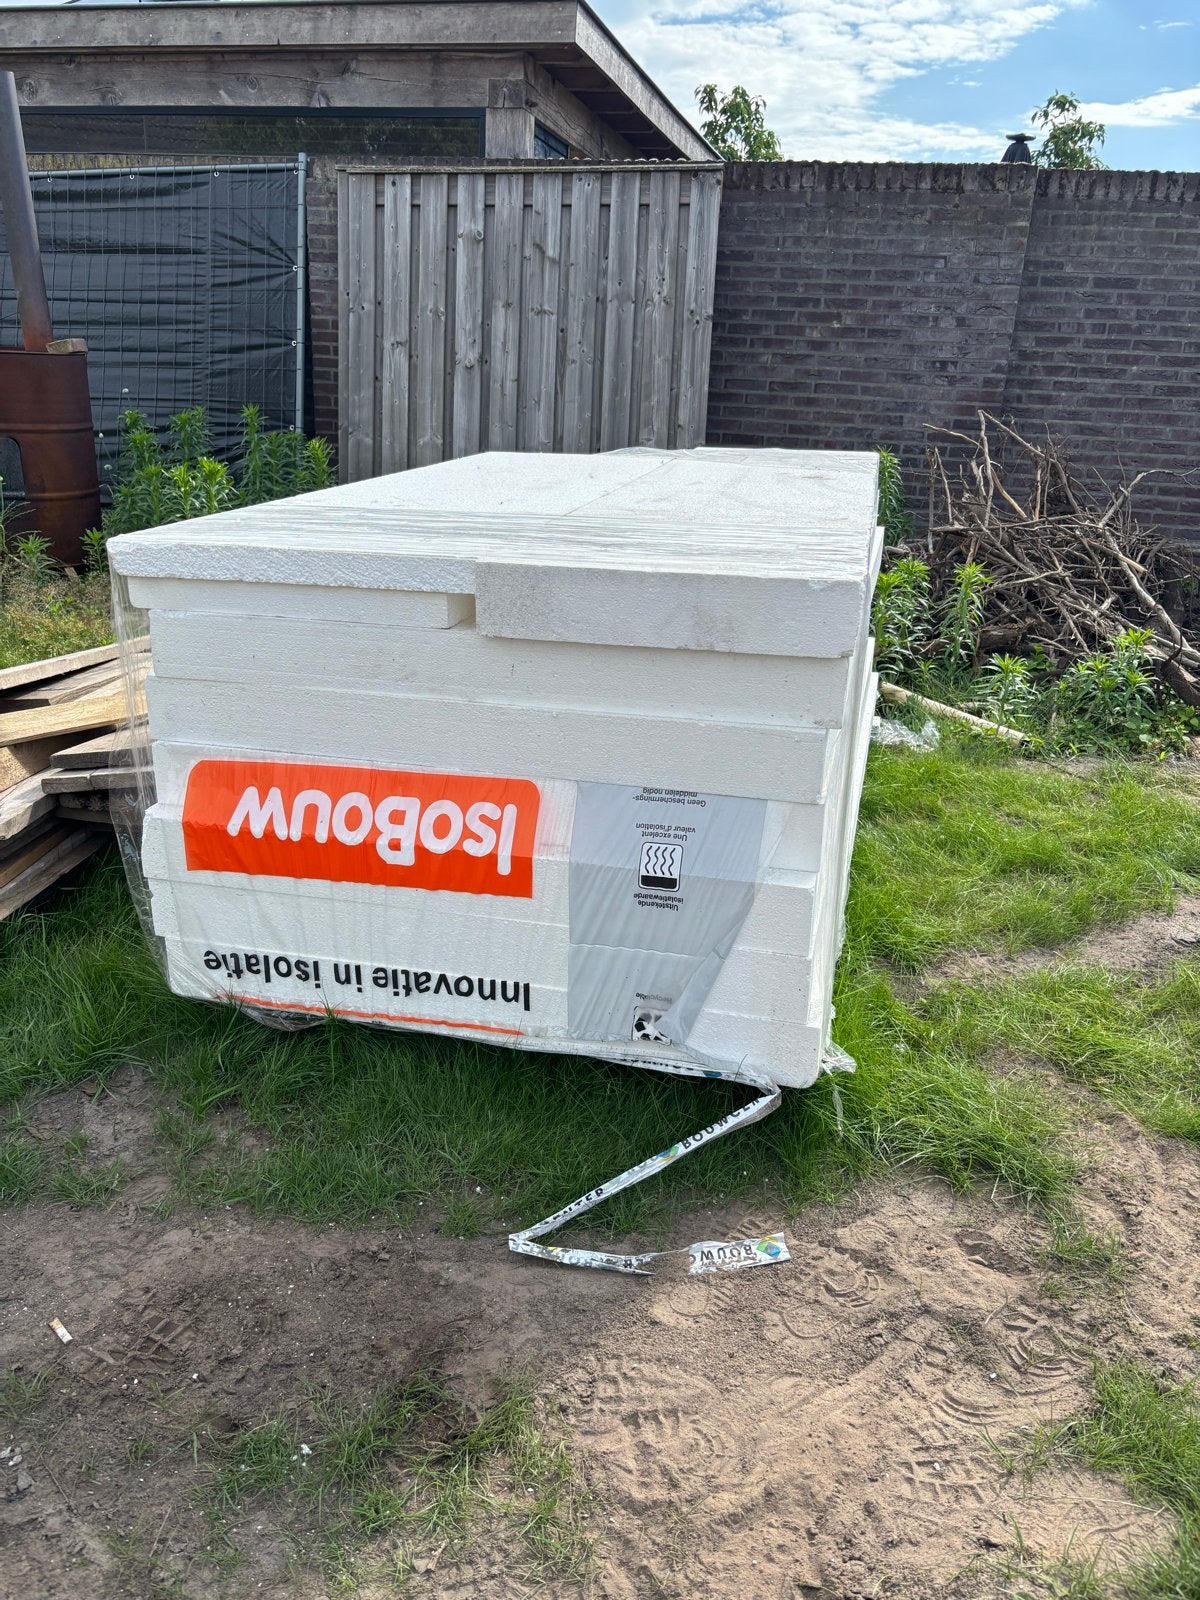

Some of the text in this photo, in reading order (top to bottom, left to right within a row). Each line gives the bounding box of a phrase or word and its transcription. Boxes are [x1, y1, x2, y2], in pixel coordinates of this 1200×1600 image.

[632, 794, 707, 808] Geen beschermings-
[226, 785, 518, 876] IsoBouw
[635, 822, 696, 834] valeur d'isolation
[641, 830, 688, 842] Une excelent
[633, 892, 684, 905] isolatiewaarde
[637, 899, 679, 912] Uitstekende
[203, 949, 531, 1011] Innovatie in isolatie
